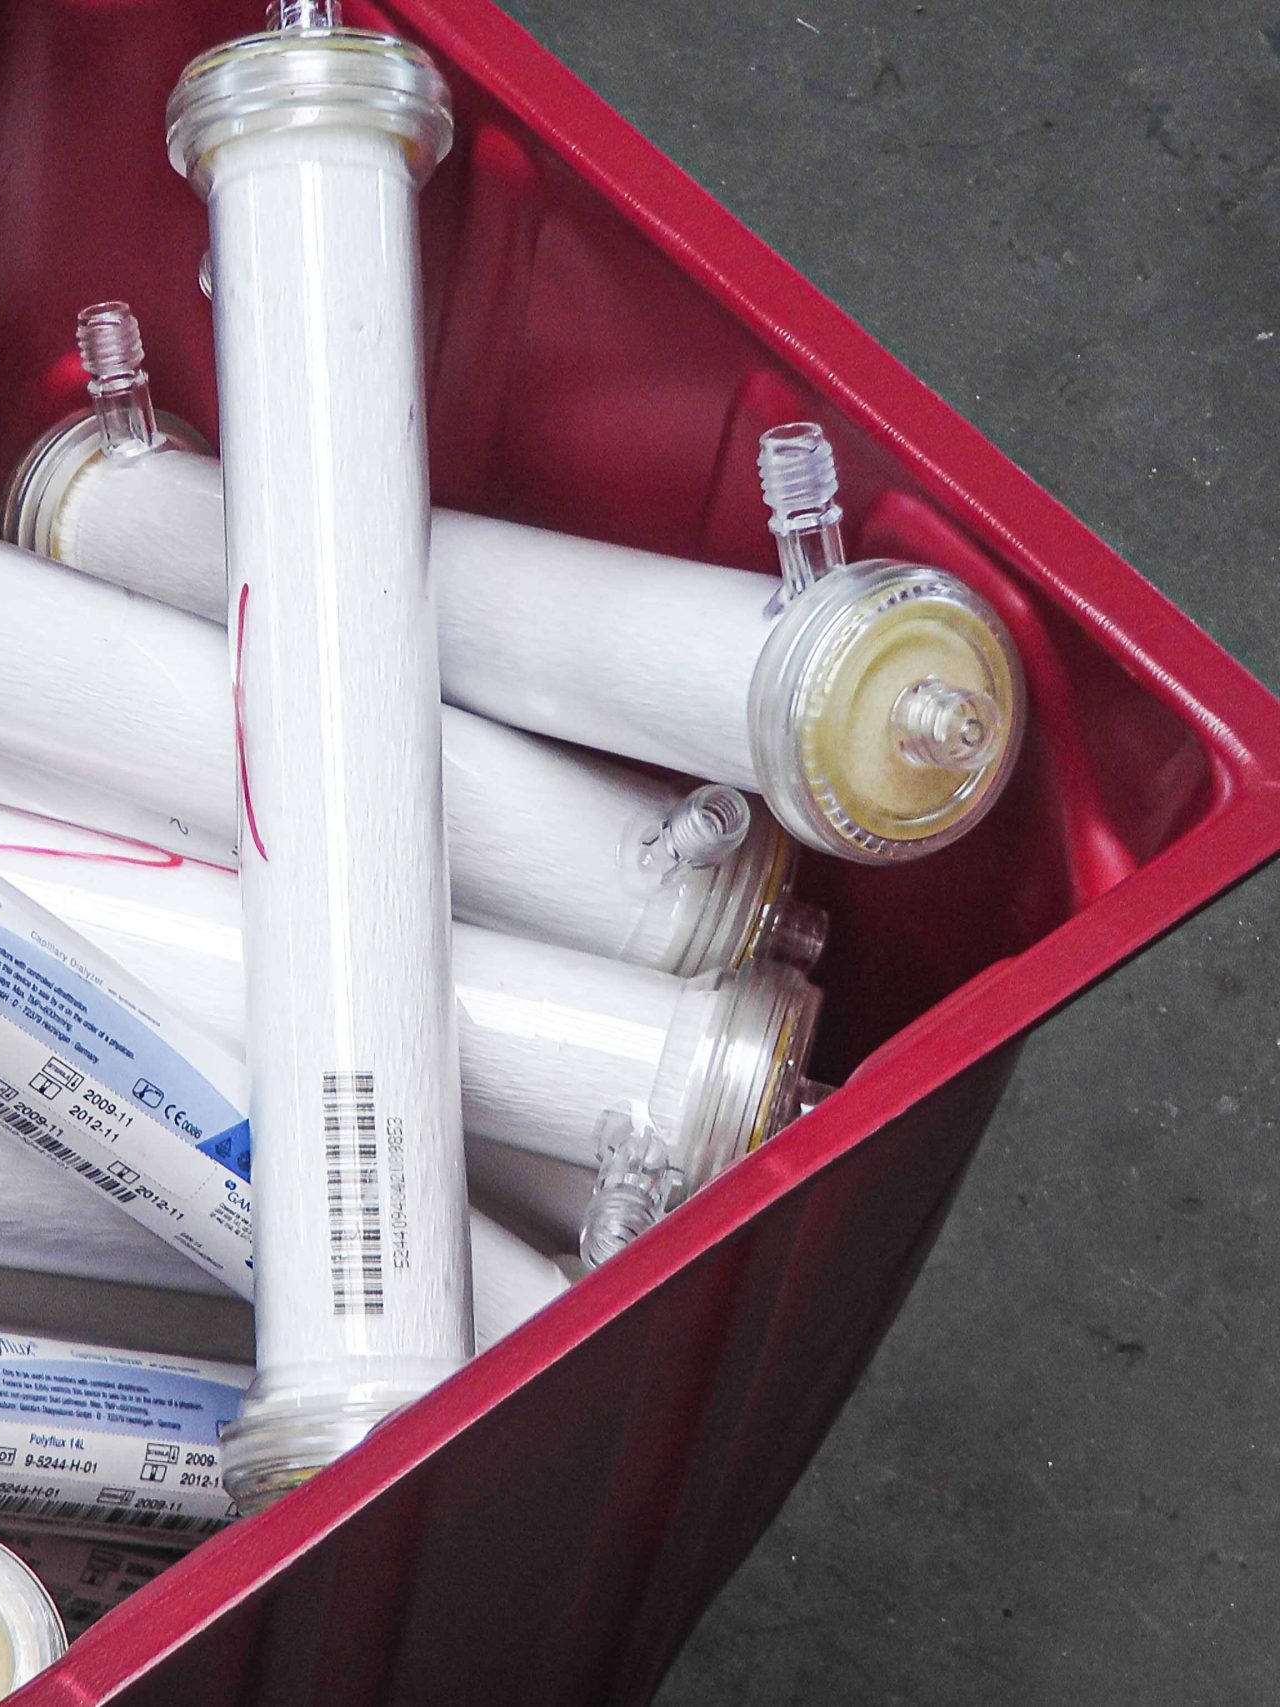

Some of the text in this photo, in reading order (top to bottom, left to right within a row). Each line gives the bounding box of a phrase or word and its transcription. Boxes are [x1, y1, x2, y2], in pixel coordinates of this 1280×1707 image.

[14, 1102, 64, 1137] 2009-11
[83, 1089, 133, 1127] 2009-11
[69, 1105, 119, 1143] 2012-11
[135, 1185, 184, 1221] 2012-11
[30, 1433, 66, 1451] Polyflux
[24, 1455, 98, 1475] 9-5244-H-01
[185, 1453, 218, 1468] 2009-
[180, 1473, 219, 1489] 2012-1
